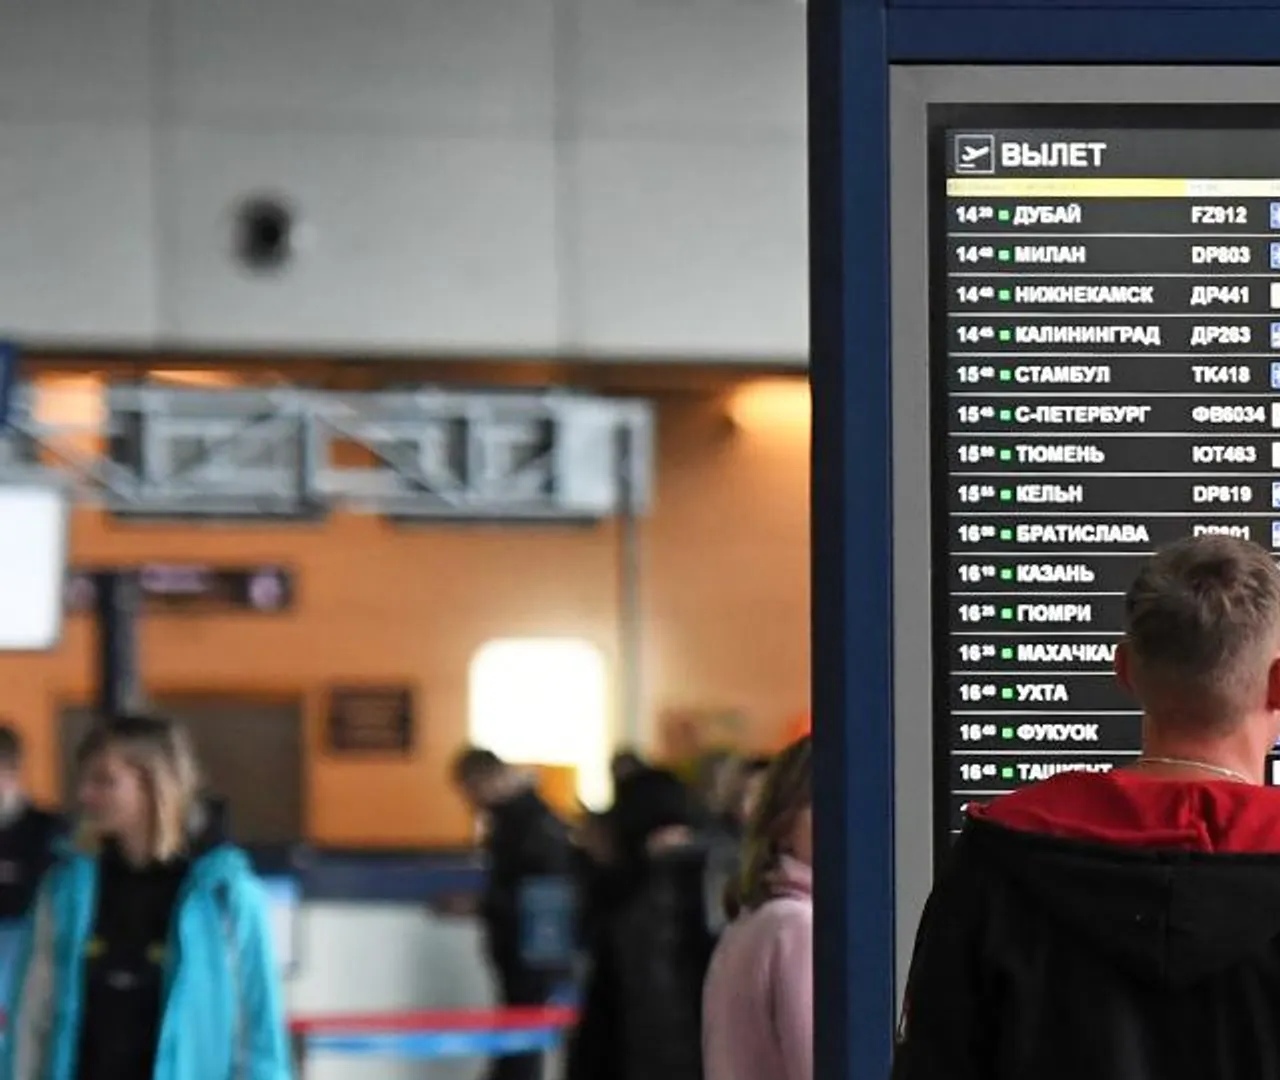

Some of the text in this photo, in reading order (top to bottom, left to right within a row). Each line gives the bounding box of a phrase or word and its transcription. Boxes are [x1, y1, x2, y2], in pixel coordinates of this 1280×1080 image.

[1002, 143, 1107, 167] ВЫЛЕТ
[1013, 203, 1081, 225] ДУБАЙ
[1015, 246, 1085, 263] МИЛАН
[1015, 286, 1249, 305] НИЖНЕКАМСК ДР441
[1015, 326, 1160, 345] КАЛИНИНГРАД
[1015, 366, 1110, 382] СТАМБУЛ
[1015, 406, 1151, 422] С-ПЕТЕРБУРГ
[1016, 445, 1104, 462] ТЮМЕНЬ
[1017, 485, 1082, 502] КЕЛЬН
[1017, 525, 1149, 542] БРАТИСЛАВА
[1017, 565, 1094, 582] КАЗАНЬ
[1018, 605, 1091, 621] ГЮМРИ
[1016, 684, 1068, 701] УХТА
[1017, 724, 1098, 740] ФУКУОК
